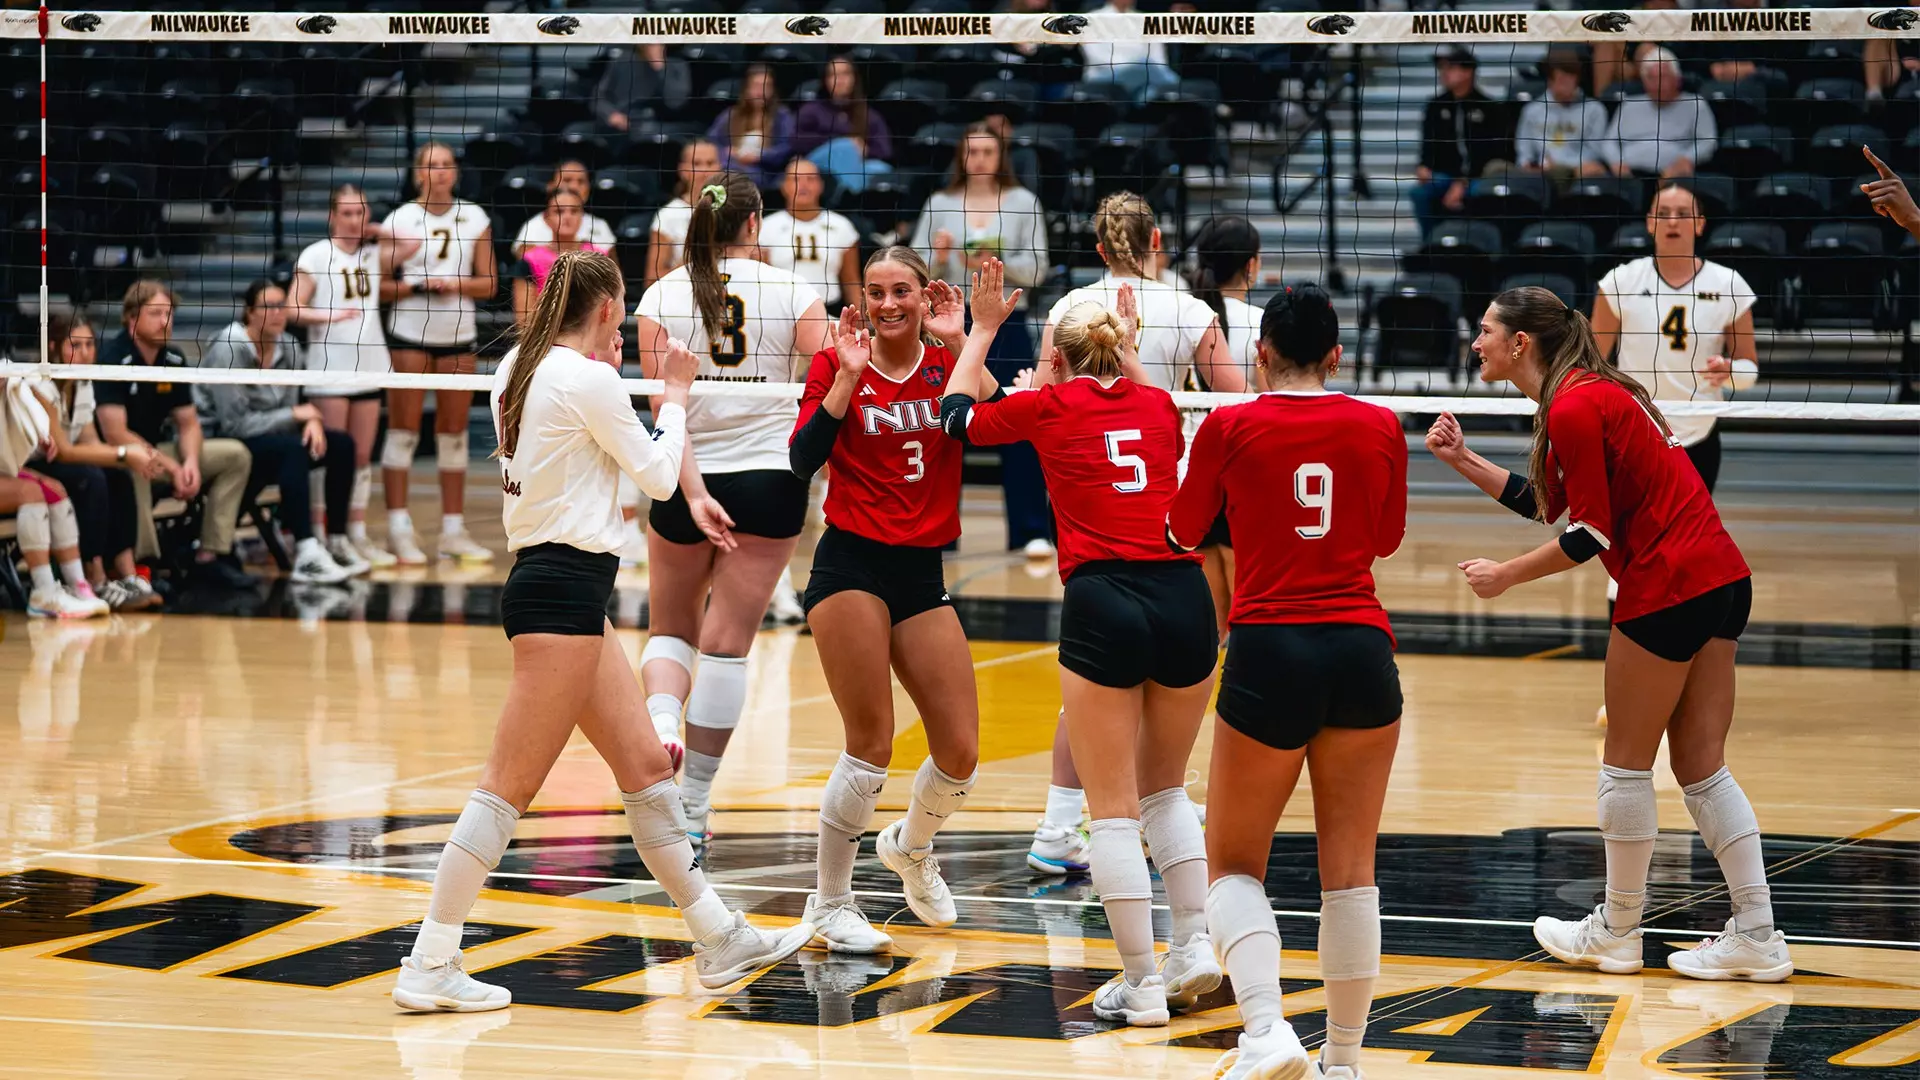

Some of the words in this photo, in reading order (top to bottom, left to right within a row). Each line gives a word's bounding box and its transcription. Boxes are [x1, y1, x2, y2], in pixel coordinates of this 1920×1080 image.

[150, 14, 250, 33] MILWAUKEE
[388, 16, 490, 35] MILWAUKEE
[631, 16, 737, 36] MILWAUKEE
[884, 16, 992, 36] MILWAUKEE
[1142, 16, 1255, 36] MILWAUKEE
[1411, 13, 1528, 34] MILWAUKEE
[1690, 11, 1812, 32] MILWAUKEE
[432, 228, 451, 260] 7
[795, 233, 818, 260] 11
[341, 267, 371, 299] 10
[710, 294, 747, 367] 3
[1661, 305, 1688, 351] 4
[860, 397, 943, 435] NIU
[902, 440, 925, 482] 3
[1104, 429, 1148, 494] 5
[1293, 463, 1333, 540] 9
